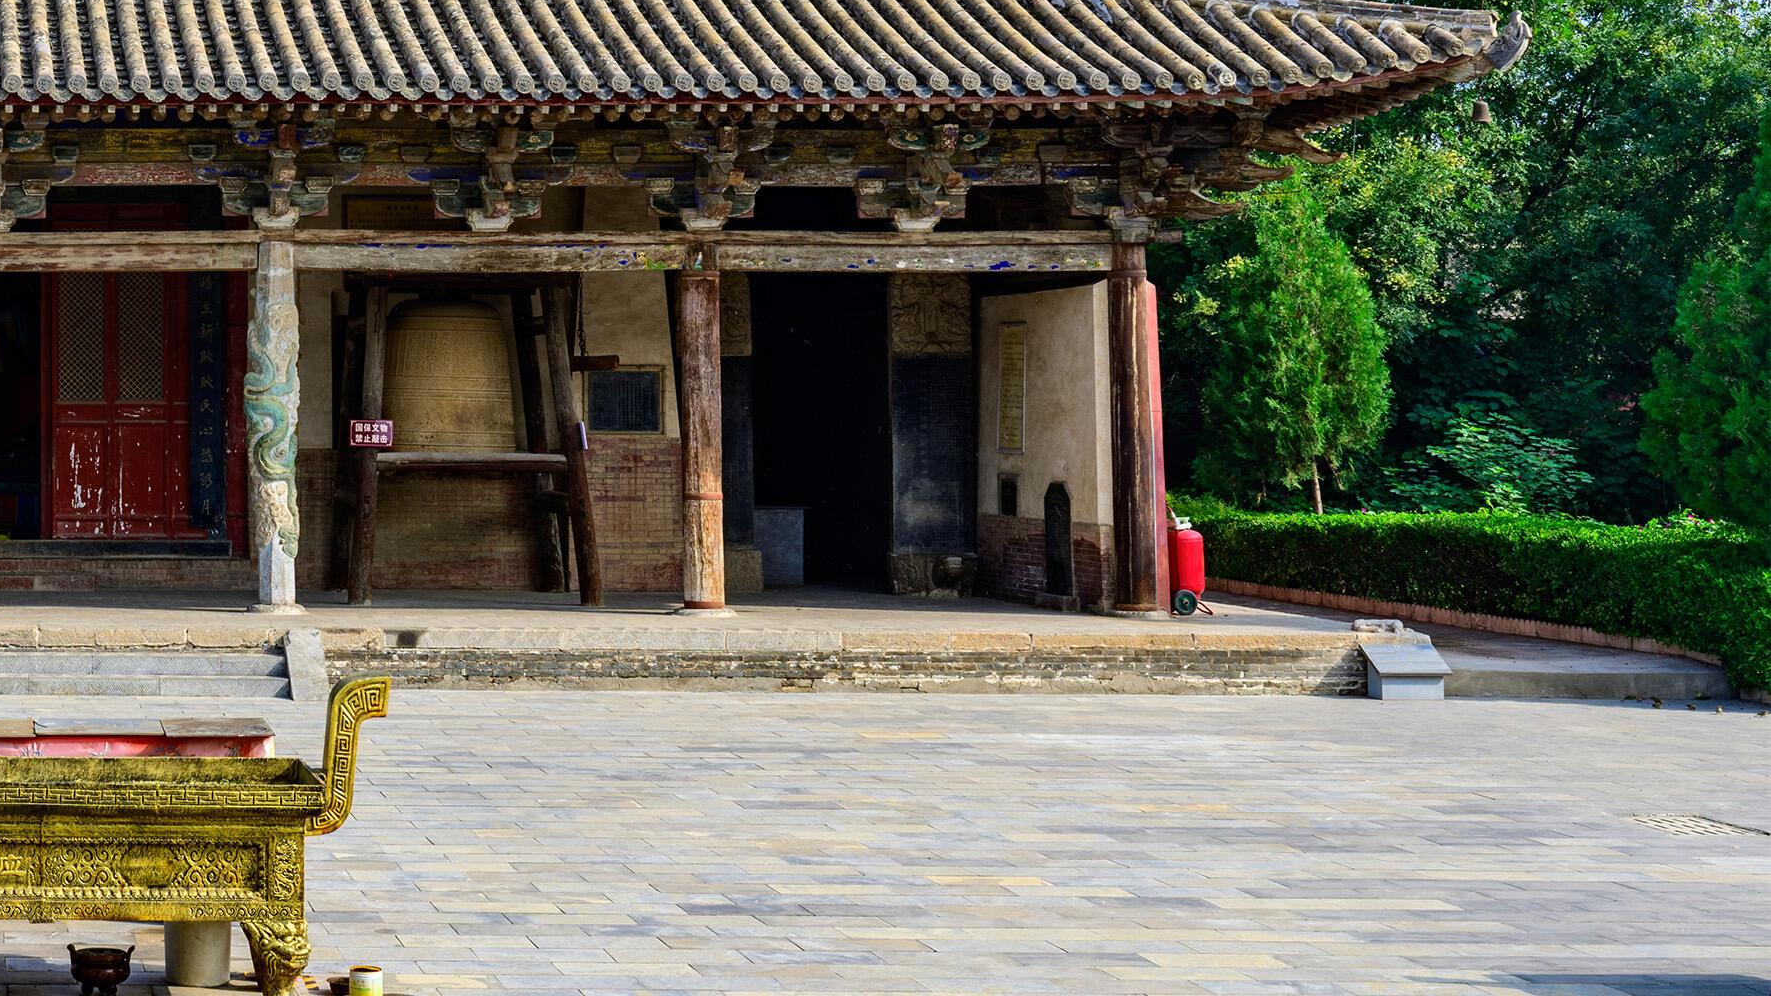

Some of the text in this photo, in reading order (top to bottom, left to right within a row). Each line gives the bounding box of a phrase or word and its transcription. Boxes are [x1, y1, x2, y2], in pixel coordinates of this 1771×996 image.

[355, 423, 388, 432] 国保文物
[355, 434, 388, 444] 禁止敲击
